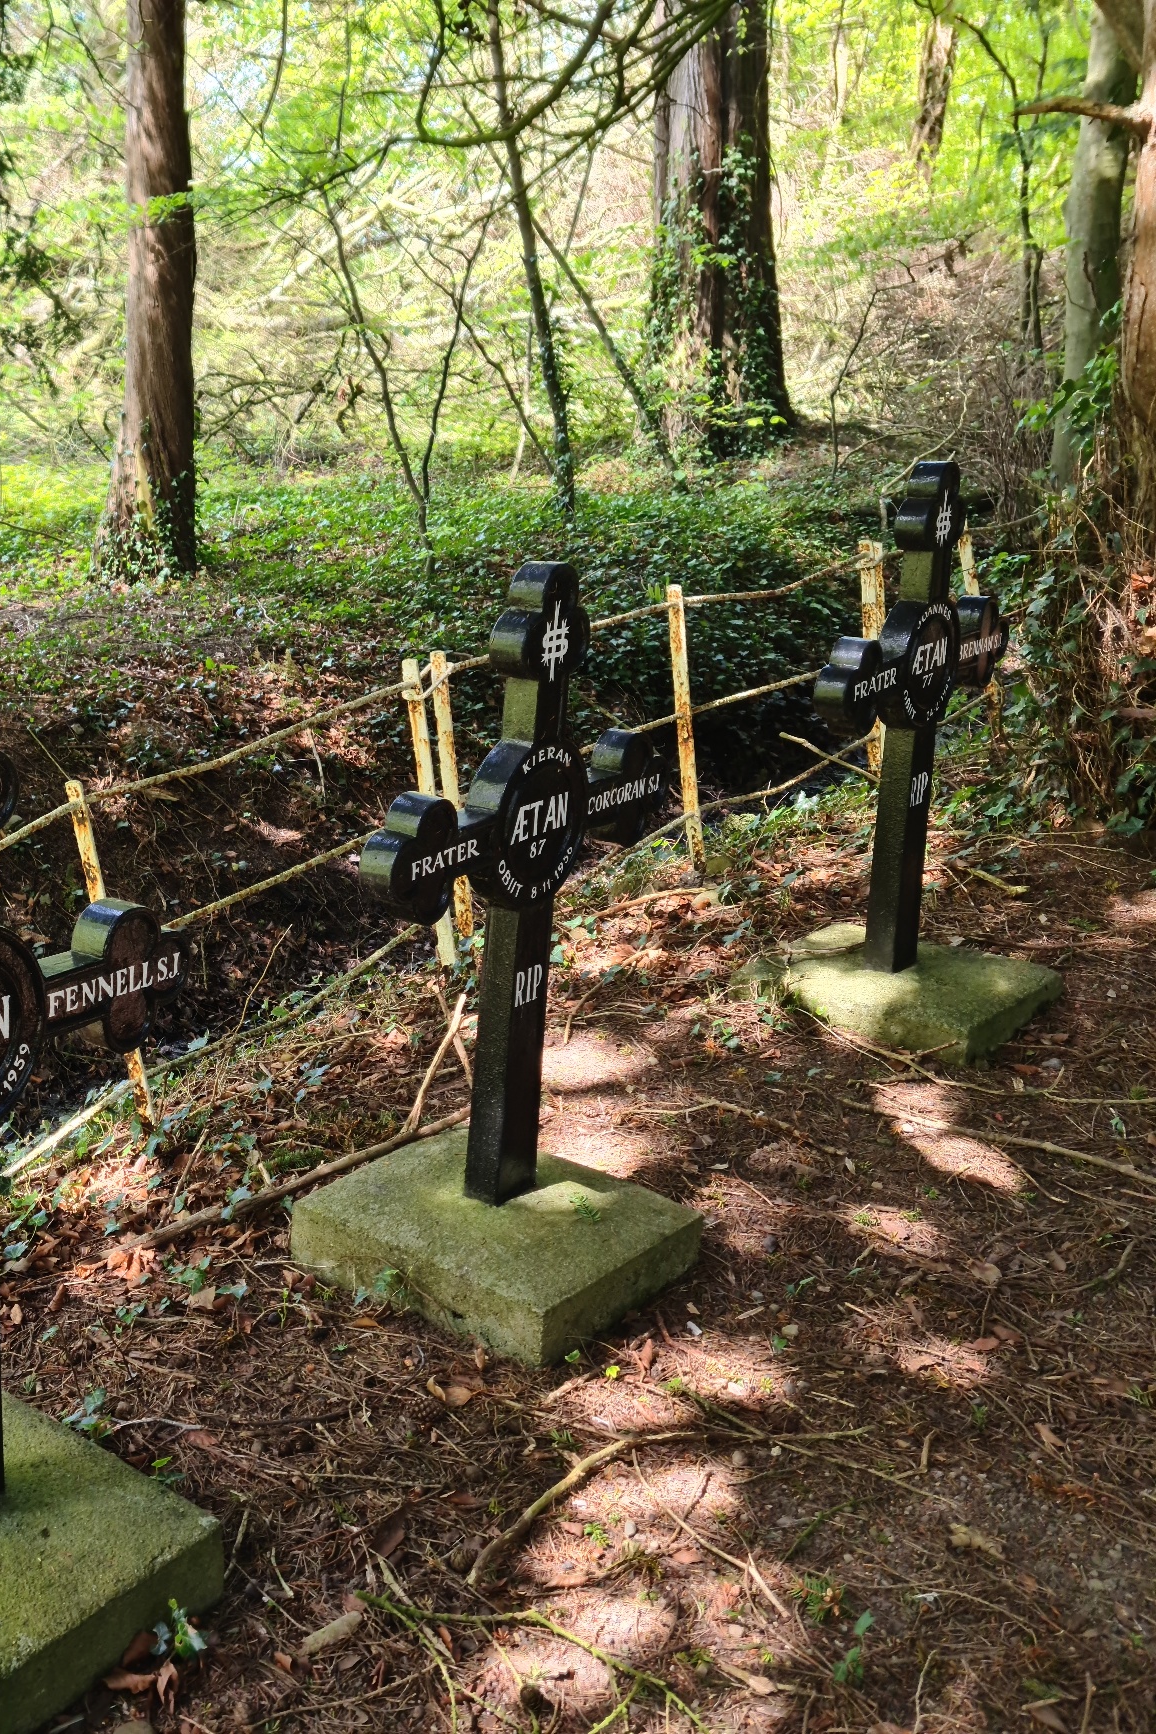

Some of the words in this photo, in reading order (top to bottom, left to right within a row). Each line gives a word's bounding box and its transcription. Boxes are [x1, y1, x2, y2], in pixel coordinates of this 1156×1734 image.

[853, 667, 897, 702] FRATER
[922, 672, 934, 689] 77
[522, 746, 573, 775] KIERAN
[587, 777, 647, 816] CORCORAN
[510, 791, 570, 846] ÆTAN
[411, 838, 481, 882] FRATER
[529, 838, 547, 859] 87
[498, 859, 524, 898] OBIIT
[47, 961, 154, 1018] FENNELL
